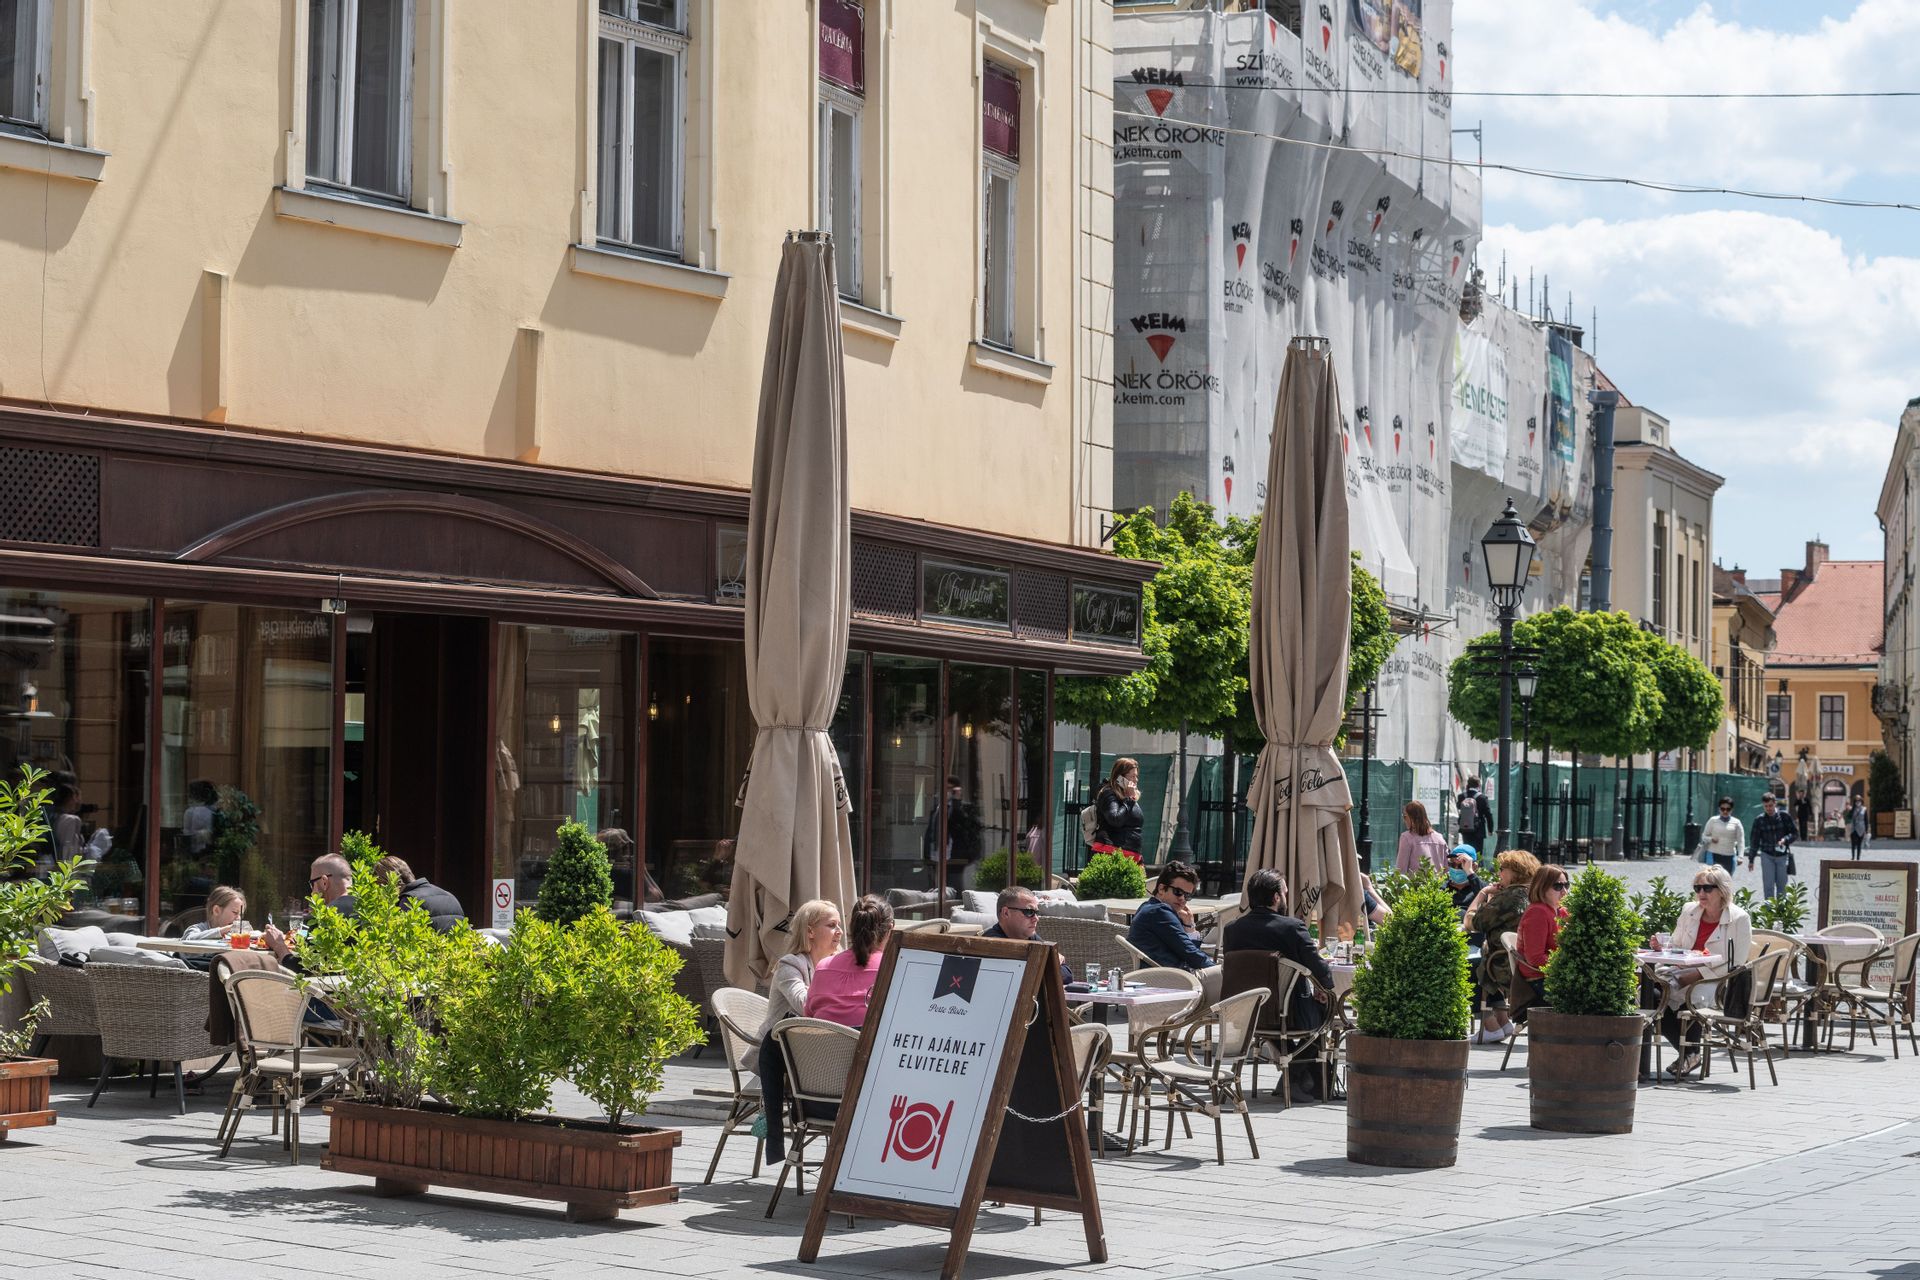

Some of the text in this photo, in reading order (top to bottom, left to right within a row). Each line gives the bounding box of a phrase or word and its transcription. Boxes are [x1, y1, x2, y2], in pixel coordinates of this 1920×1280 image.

[821, 23, 854, 54] GALÉRIA
[1131, 66, 1185, 88] KEIM
[1130, 313, 1187, 334] KEIM
[1156, 369, 1221, 395] ÖRÖKRE
[1832, 872, 1871, 881] MARHAGULYÁS
[893, 1033, 986, 1058] HETI AJÁNLAT
[898, 1053, 969, 1076] ELVITELRE
